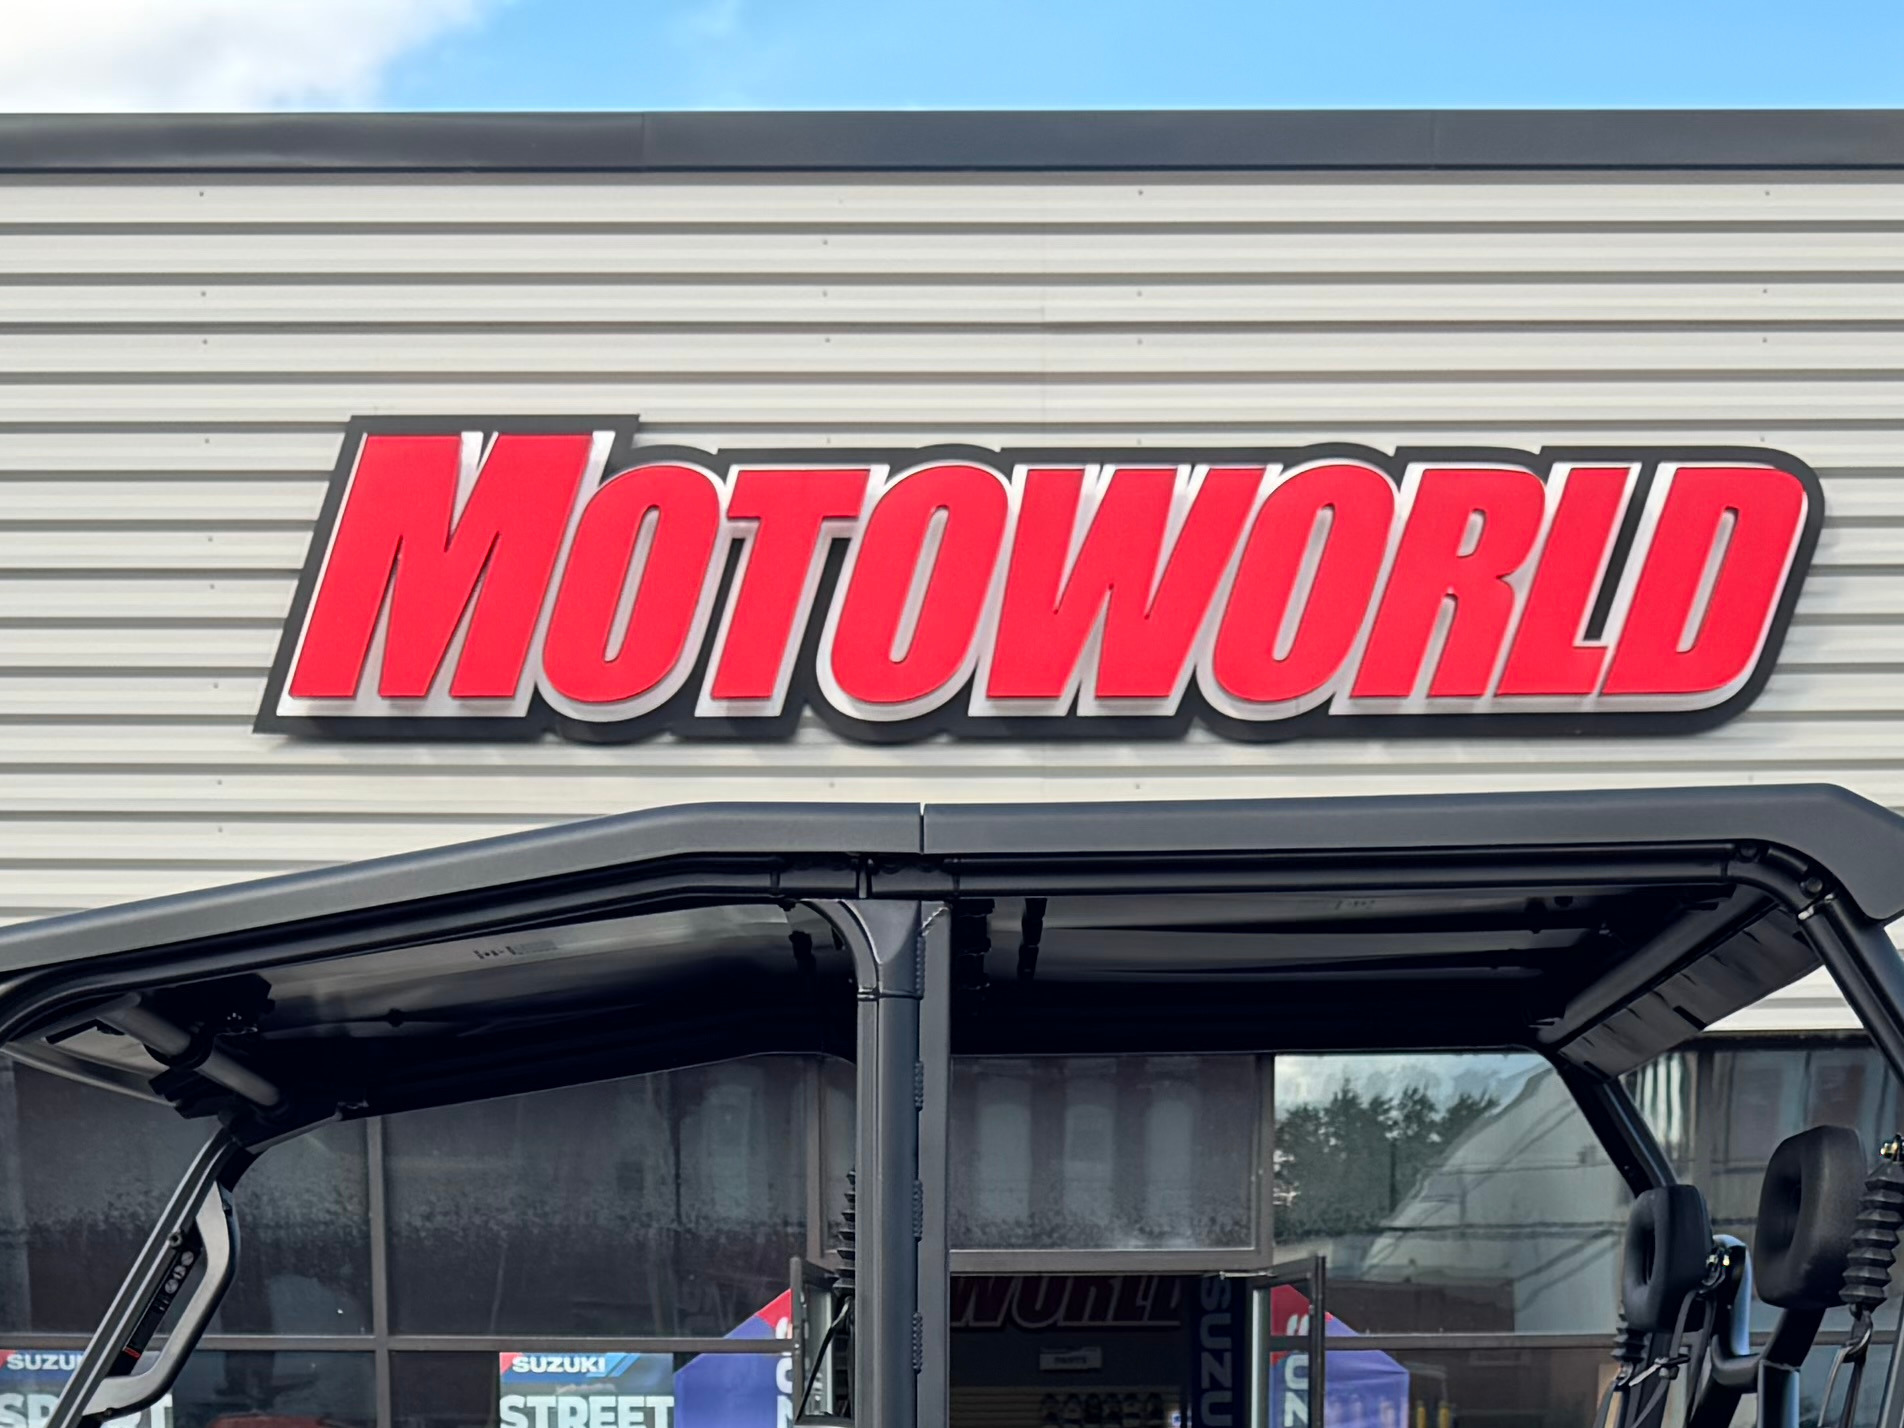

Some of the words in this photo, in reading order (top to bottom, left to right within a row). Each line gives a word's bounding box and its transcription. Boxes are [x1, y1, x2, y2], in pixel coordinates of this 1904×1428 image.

[274, 425, 1818, 715] MOTOWORLD
[7, 1353, 85, 1371] SUZU
[512, 1356, 606, 1373] SUZUKI
